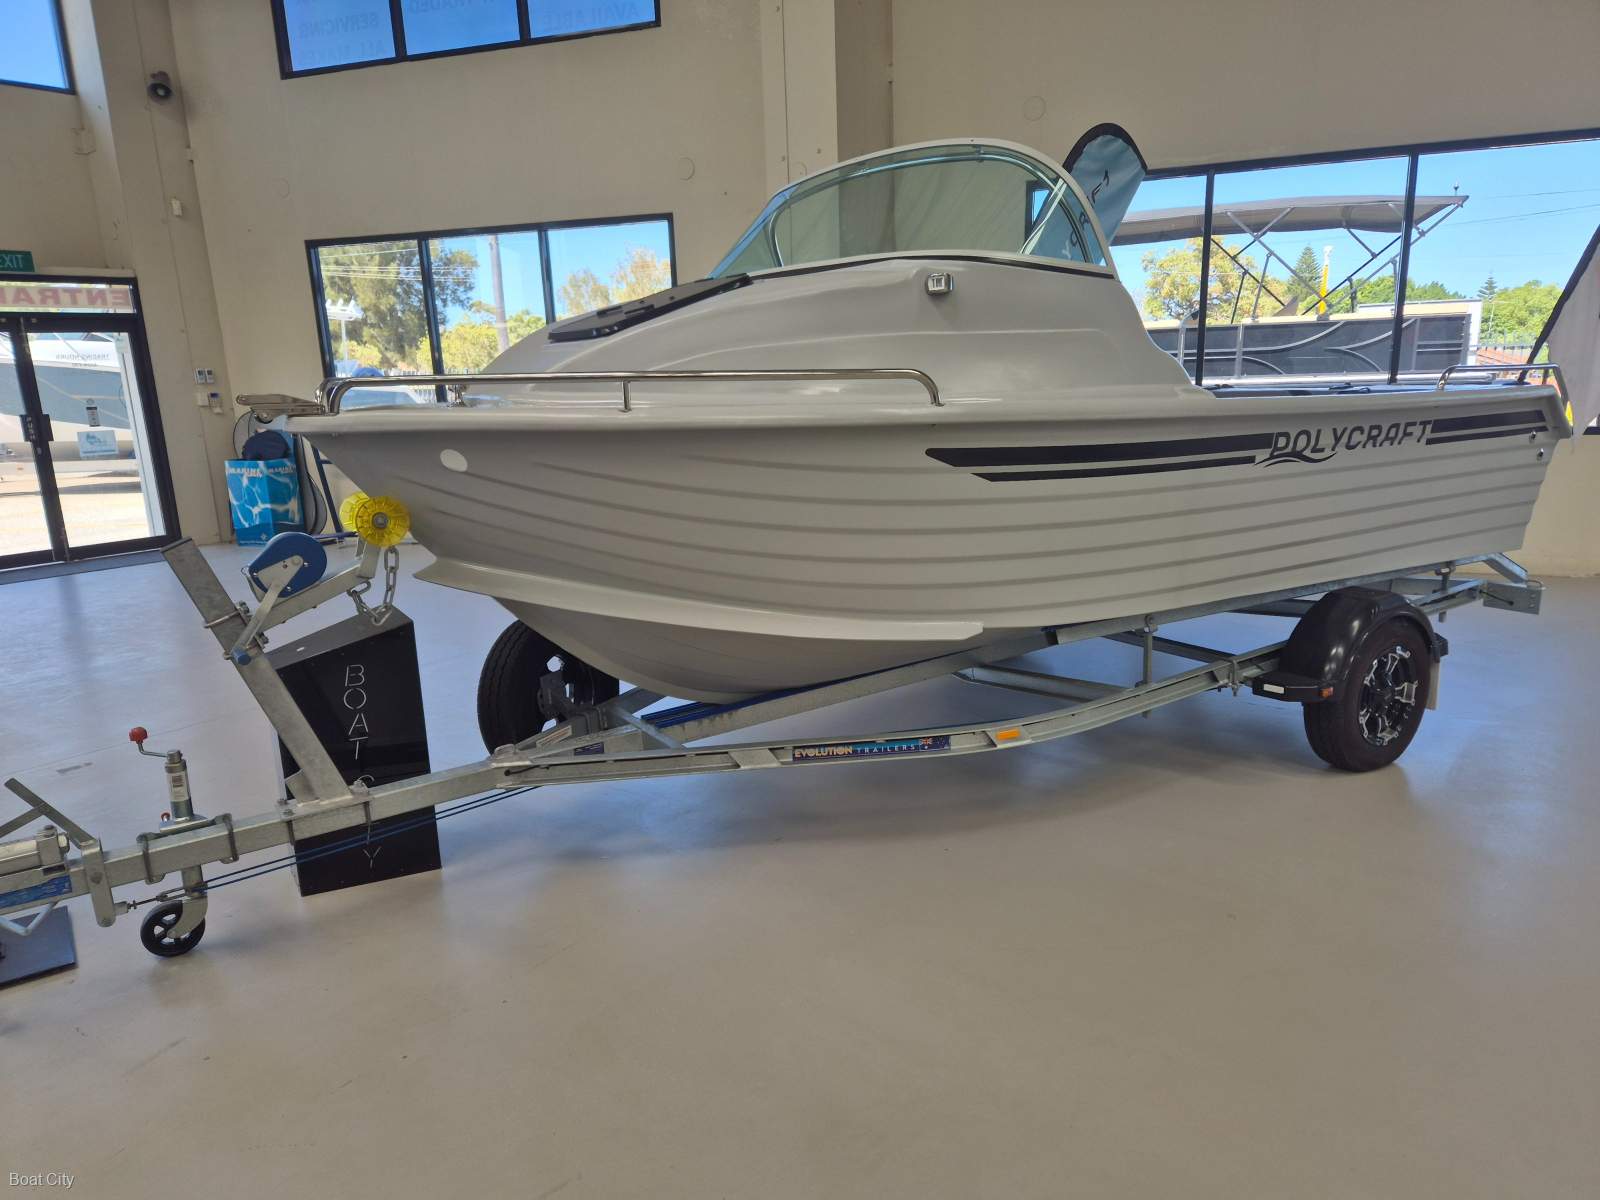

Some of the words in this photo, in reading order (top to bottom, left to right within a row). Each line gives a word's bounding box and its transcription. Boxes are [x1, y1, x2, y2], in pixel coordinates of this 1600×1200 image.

[1269, 420, 1433, 457] POLYCRAFT
[343, 664, 369, 760] BOAT
[794, 745, 853, 758] EVOLUTION
[857, 743, 916, 754] TRAILERS
